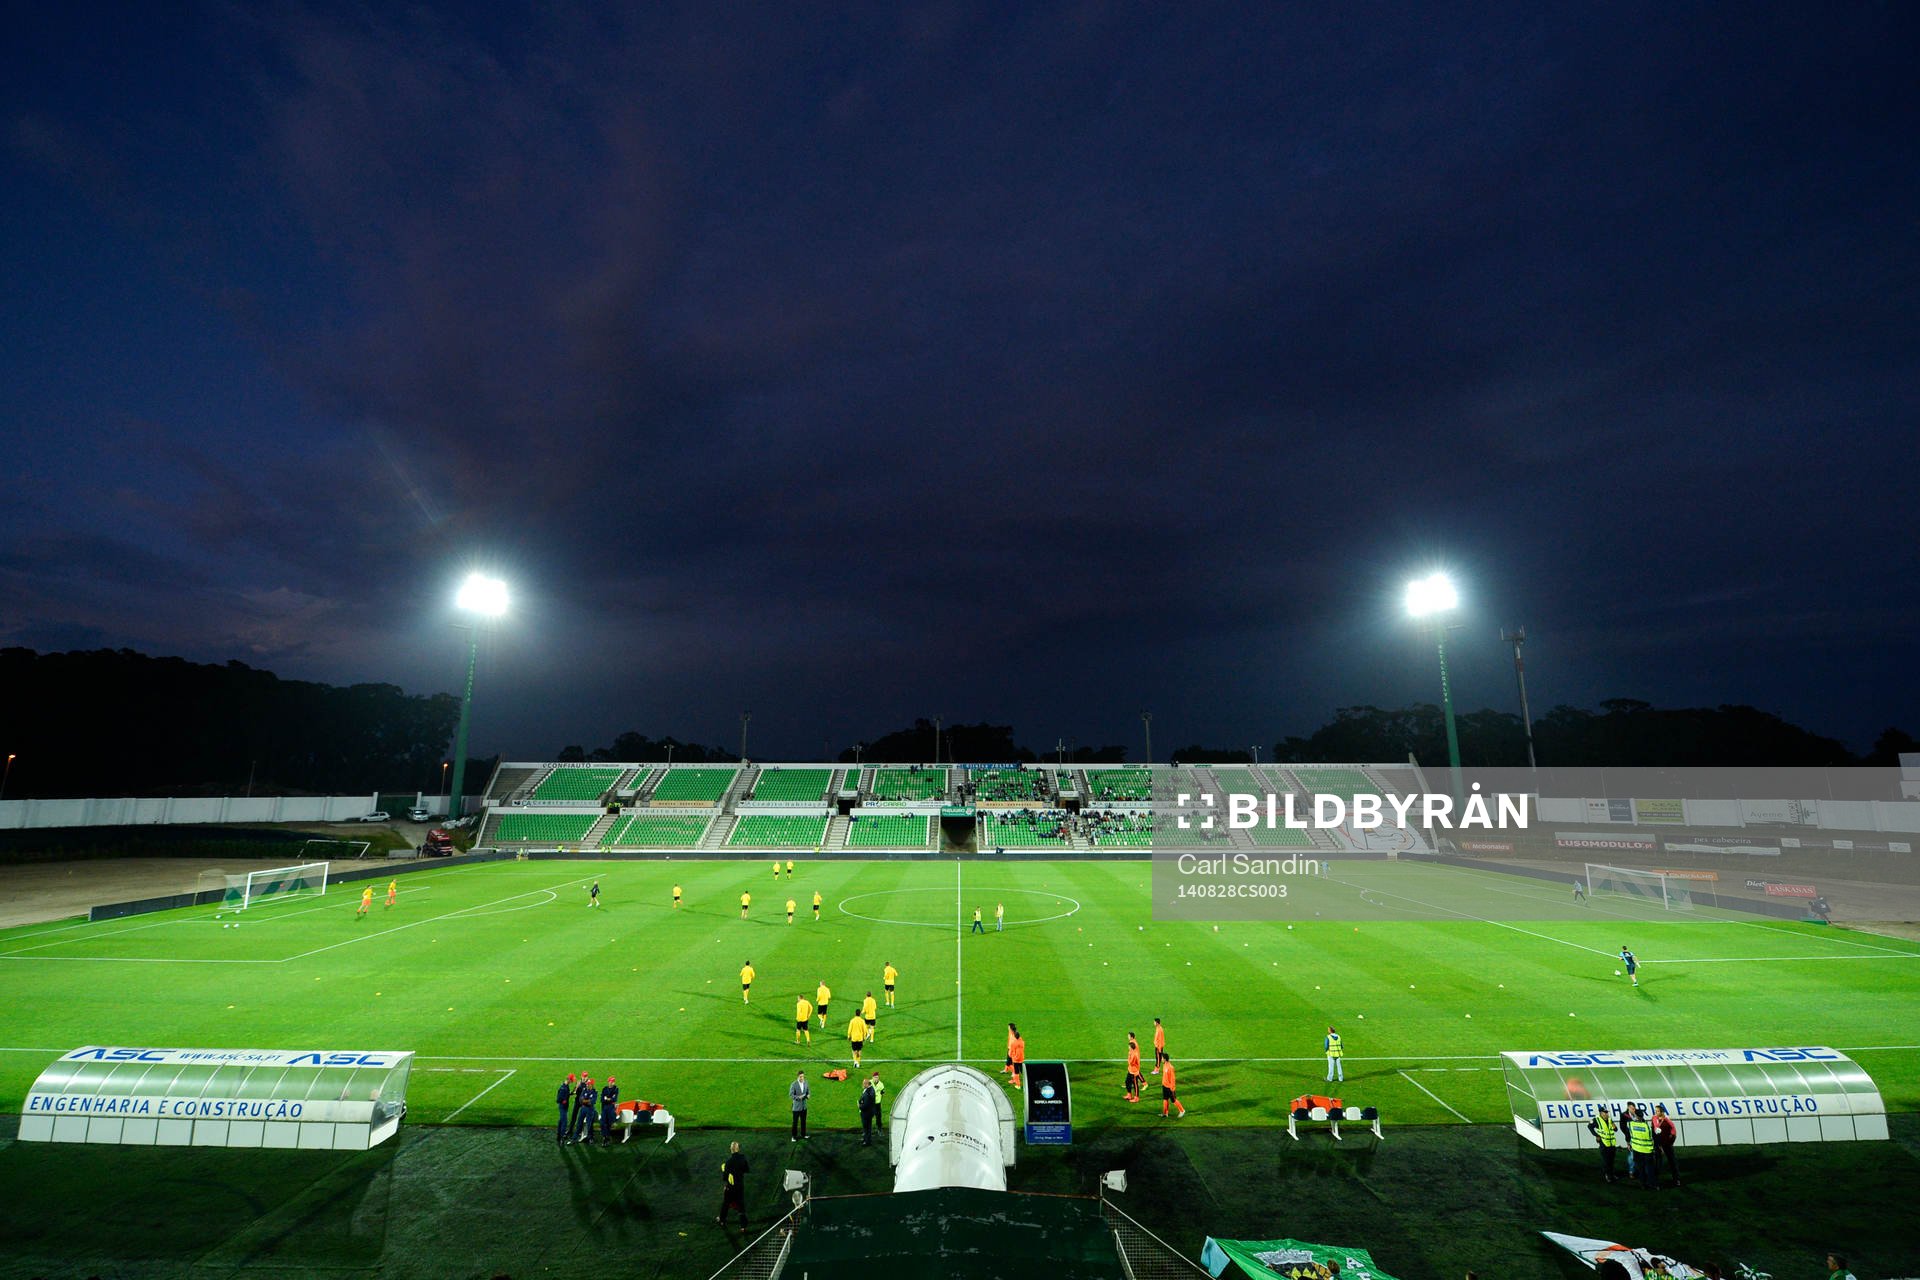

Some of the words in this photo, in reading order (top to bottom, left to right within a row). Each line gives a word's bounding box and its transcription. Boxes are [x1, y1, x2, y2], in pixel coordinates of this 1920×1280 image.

[70, 1048, 176, 1063] ASC
[288, 1053, 386, 1066] ASC
[1529, 1053, 1624, 1066] ASC
[1743, 1047, 1838, 1062] ASC
[30, 1096, 150, 1114] ENGENHARIA
[157, 1099, 169, 1114] E
[173, 1099, 304, 1120] CONSTRUÇÃO
[1546, 1102, 1670, 1119] ENGENHRIA
[1675, 1101, 1686, 1116] E
[1694, 1095, 1819, 1117] CONSTRUÇÃO
